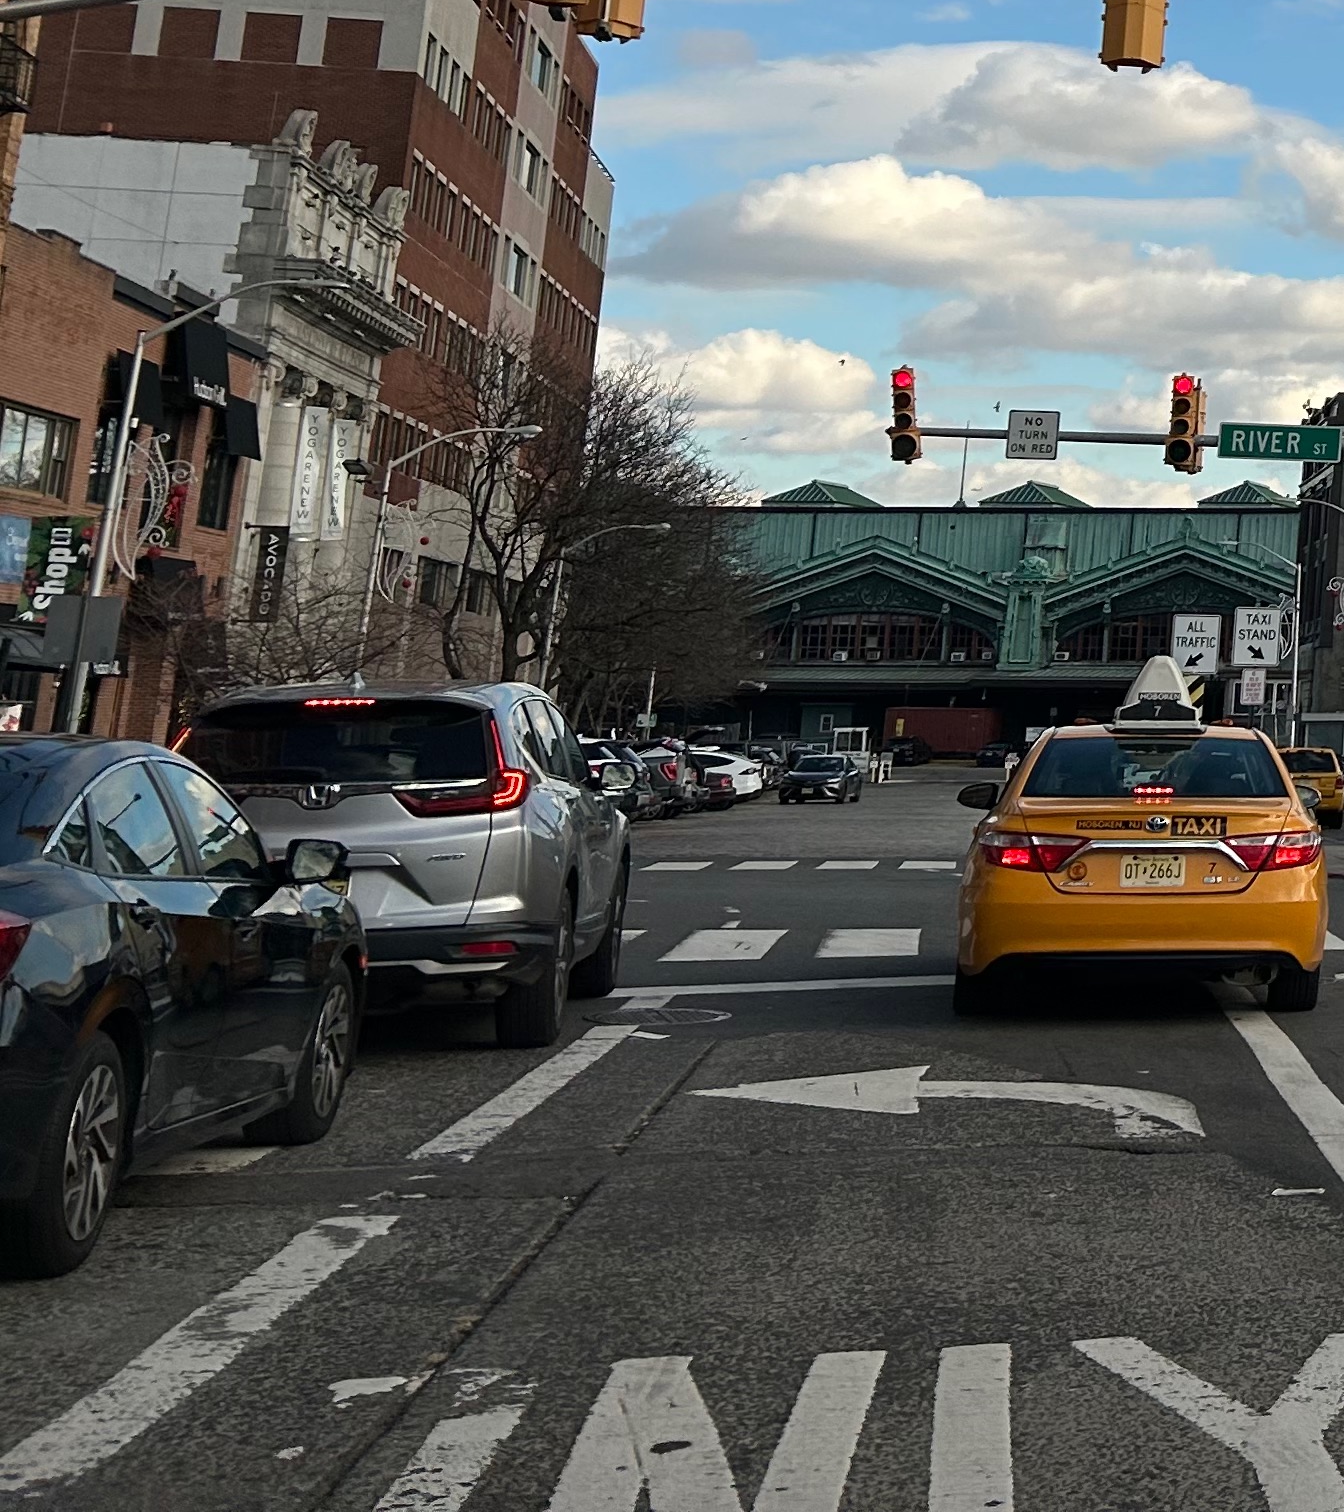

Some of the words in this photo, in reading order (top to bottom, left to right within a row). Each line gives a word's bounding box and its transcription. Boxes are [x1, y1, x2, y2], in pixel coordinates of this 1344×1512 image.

[1024, 416, 1043, 426] NO
[1018, 429, 1048, 440] TURN
[1010, 442, 1026, 453] ON
[1030, 443, 1053, 454] RED
[1231, 429, 1301, 454] RIVER
[1313, 442, 1327, 455] ST
[296, 414, 320, 519] YOGARENEW
[258, 533, 281, 616] AVOCADO
[1246, 613, 1272, 626] TAXI
[1187, 621, 1206, 633] ALL
[1237, 629, 1276, 641] STAND
[1175, 636, 1217, 648] TRAFFIC
[1139, 692, 1181, 701] HOBOKEN
[1153, 705, 1162, 717] 7
[1128, 820, 1141, 829] NJ
[1173, 818, 1221, 835] TAXI
[1208, 862, 1217, 874] 7
